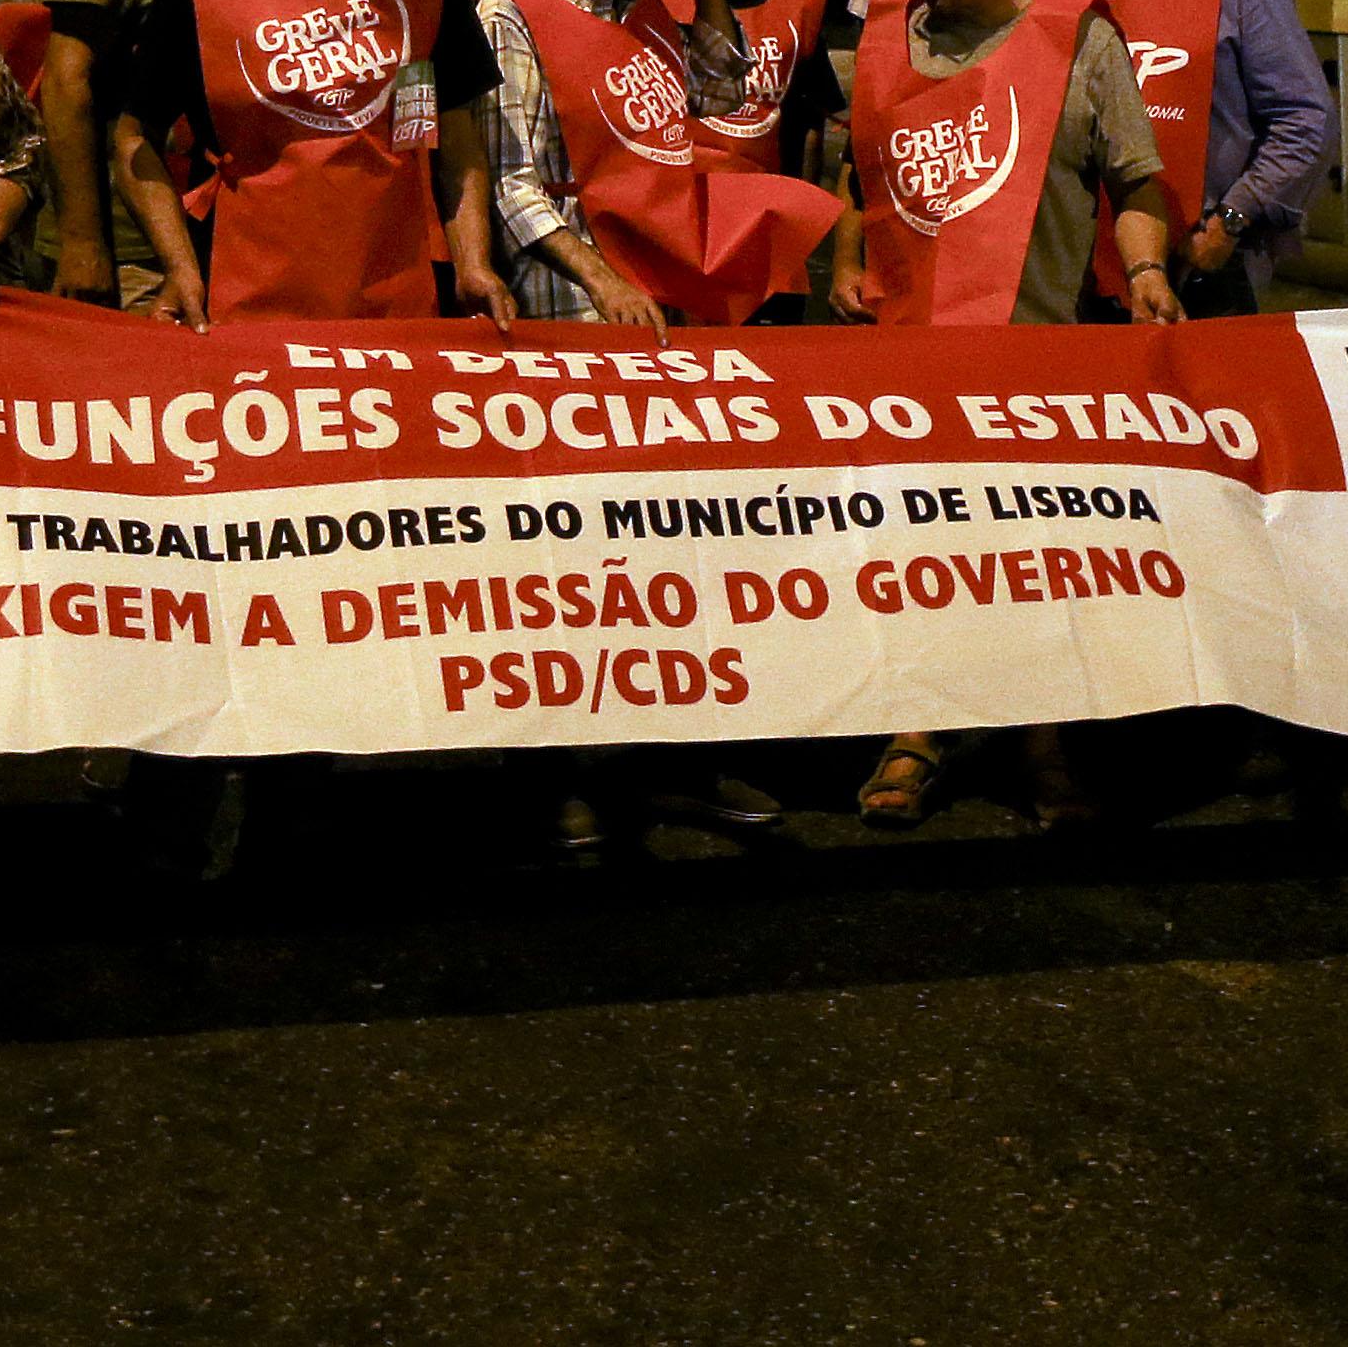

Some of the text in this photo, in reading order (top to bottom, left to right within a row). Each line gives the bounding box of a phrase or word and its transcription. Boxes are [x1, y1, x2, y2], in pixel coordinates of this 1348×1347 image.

[267, 30, 398, 95] GERAL
[890, 104, 989, 162] GREVE
[285, 343, 776, 383] EM DEFESA
[435, 392, 782, 451] SOCIAIS
[805, 395, 933, 442] DO
[959, 391, 1261, 463] ESTADO
[6, 505, 487, 562] TRABALHADORES
[506, 500, 584, 540] DO
[604, 483, 885, 540] MUNICÍPIO
[904, 487, 971, 526] DE
[985, 483, 1160, 524] LISBOA
[240, 594, 295, 647] A
[320, 556, 699, 645] DEMISSÃO
[723, 566, 831, 627] DO
[855, 546, 1188, 617] GOVERNO
[439, 646, 751, 714] PSD/CDS
